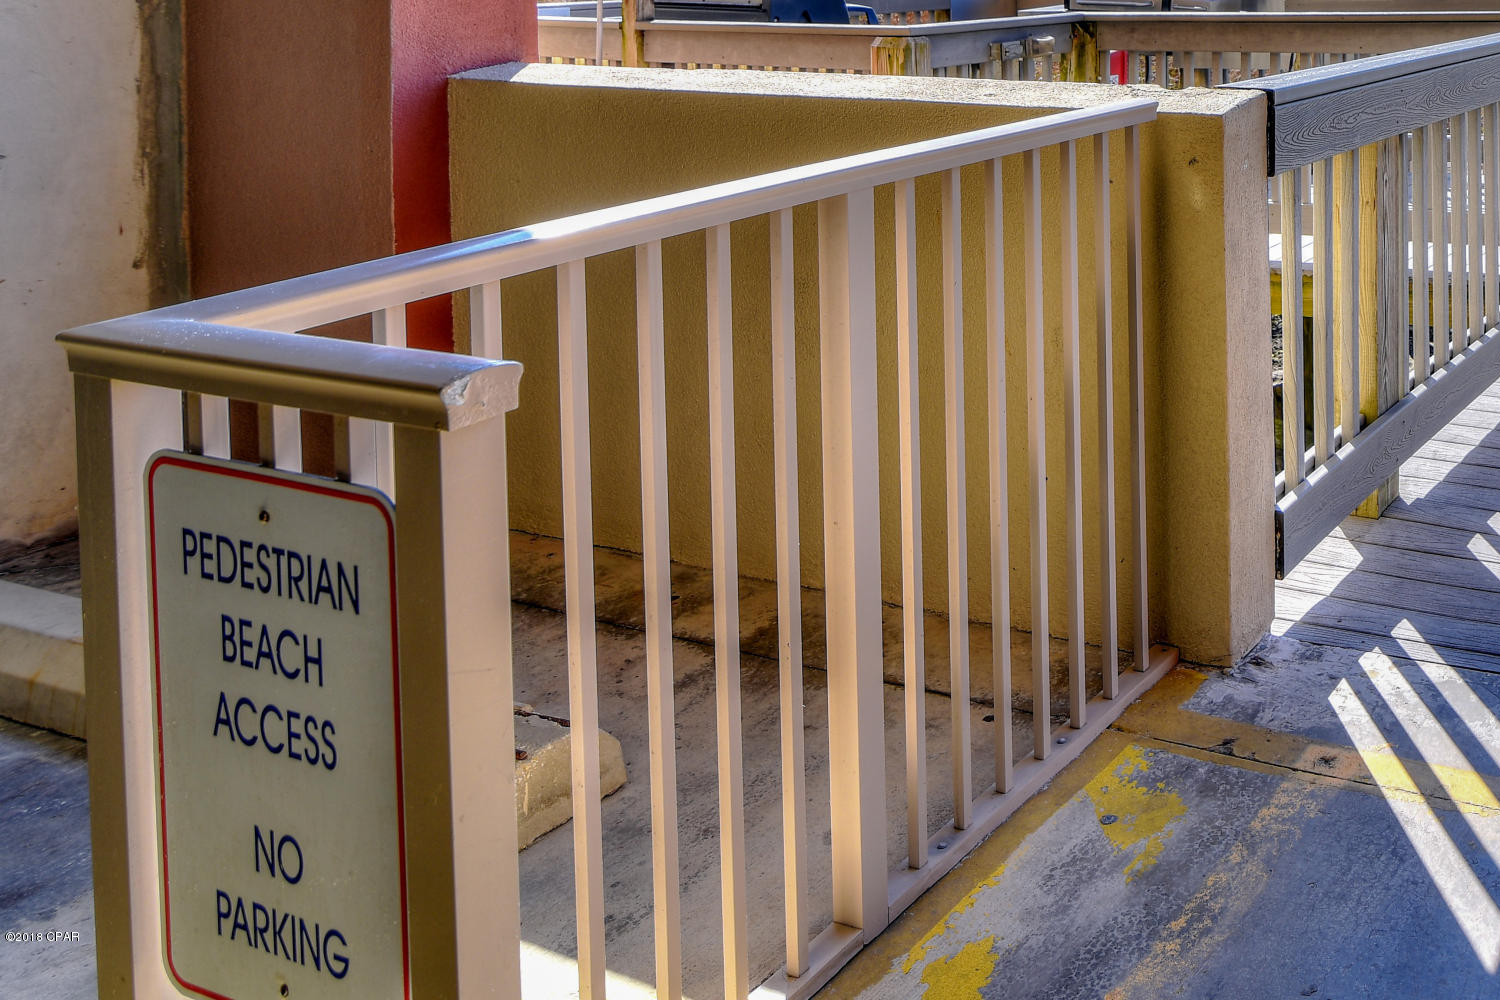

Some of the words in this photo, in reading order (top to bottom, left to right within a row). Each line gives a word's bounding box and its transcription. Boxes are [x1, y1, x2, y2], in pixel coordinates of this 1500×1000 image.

[181, 528, 361, 616] PEDESTRIAN
[221, 614, 323, 688] BEACH
[213, 692, 338, 771] ACCESS
[254, 825, 305, 885] NO
[216, 889, 351, 979] PARKING
